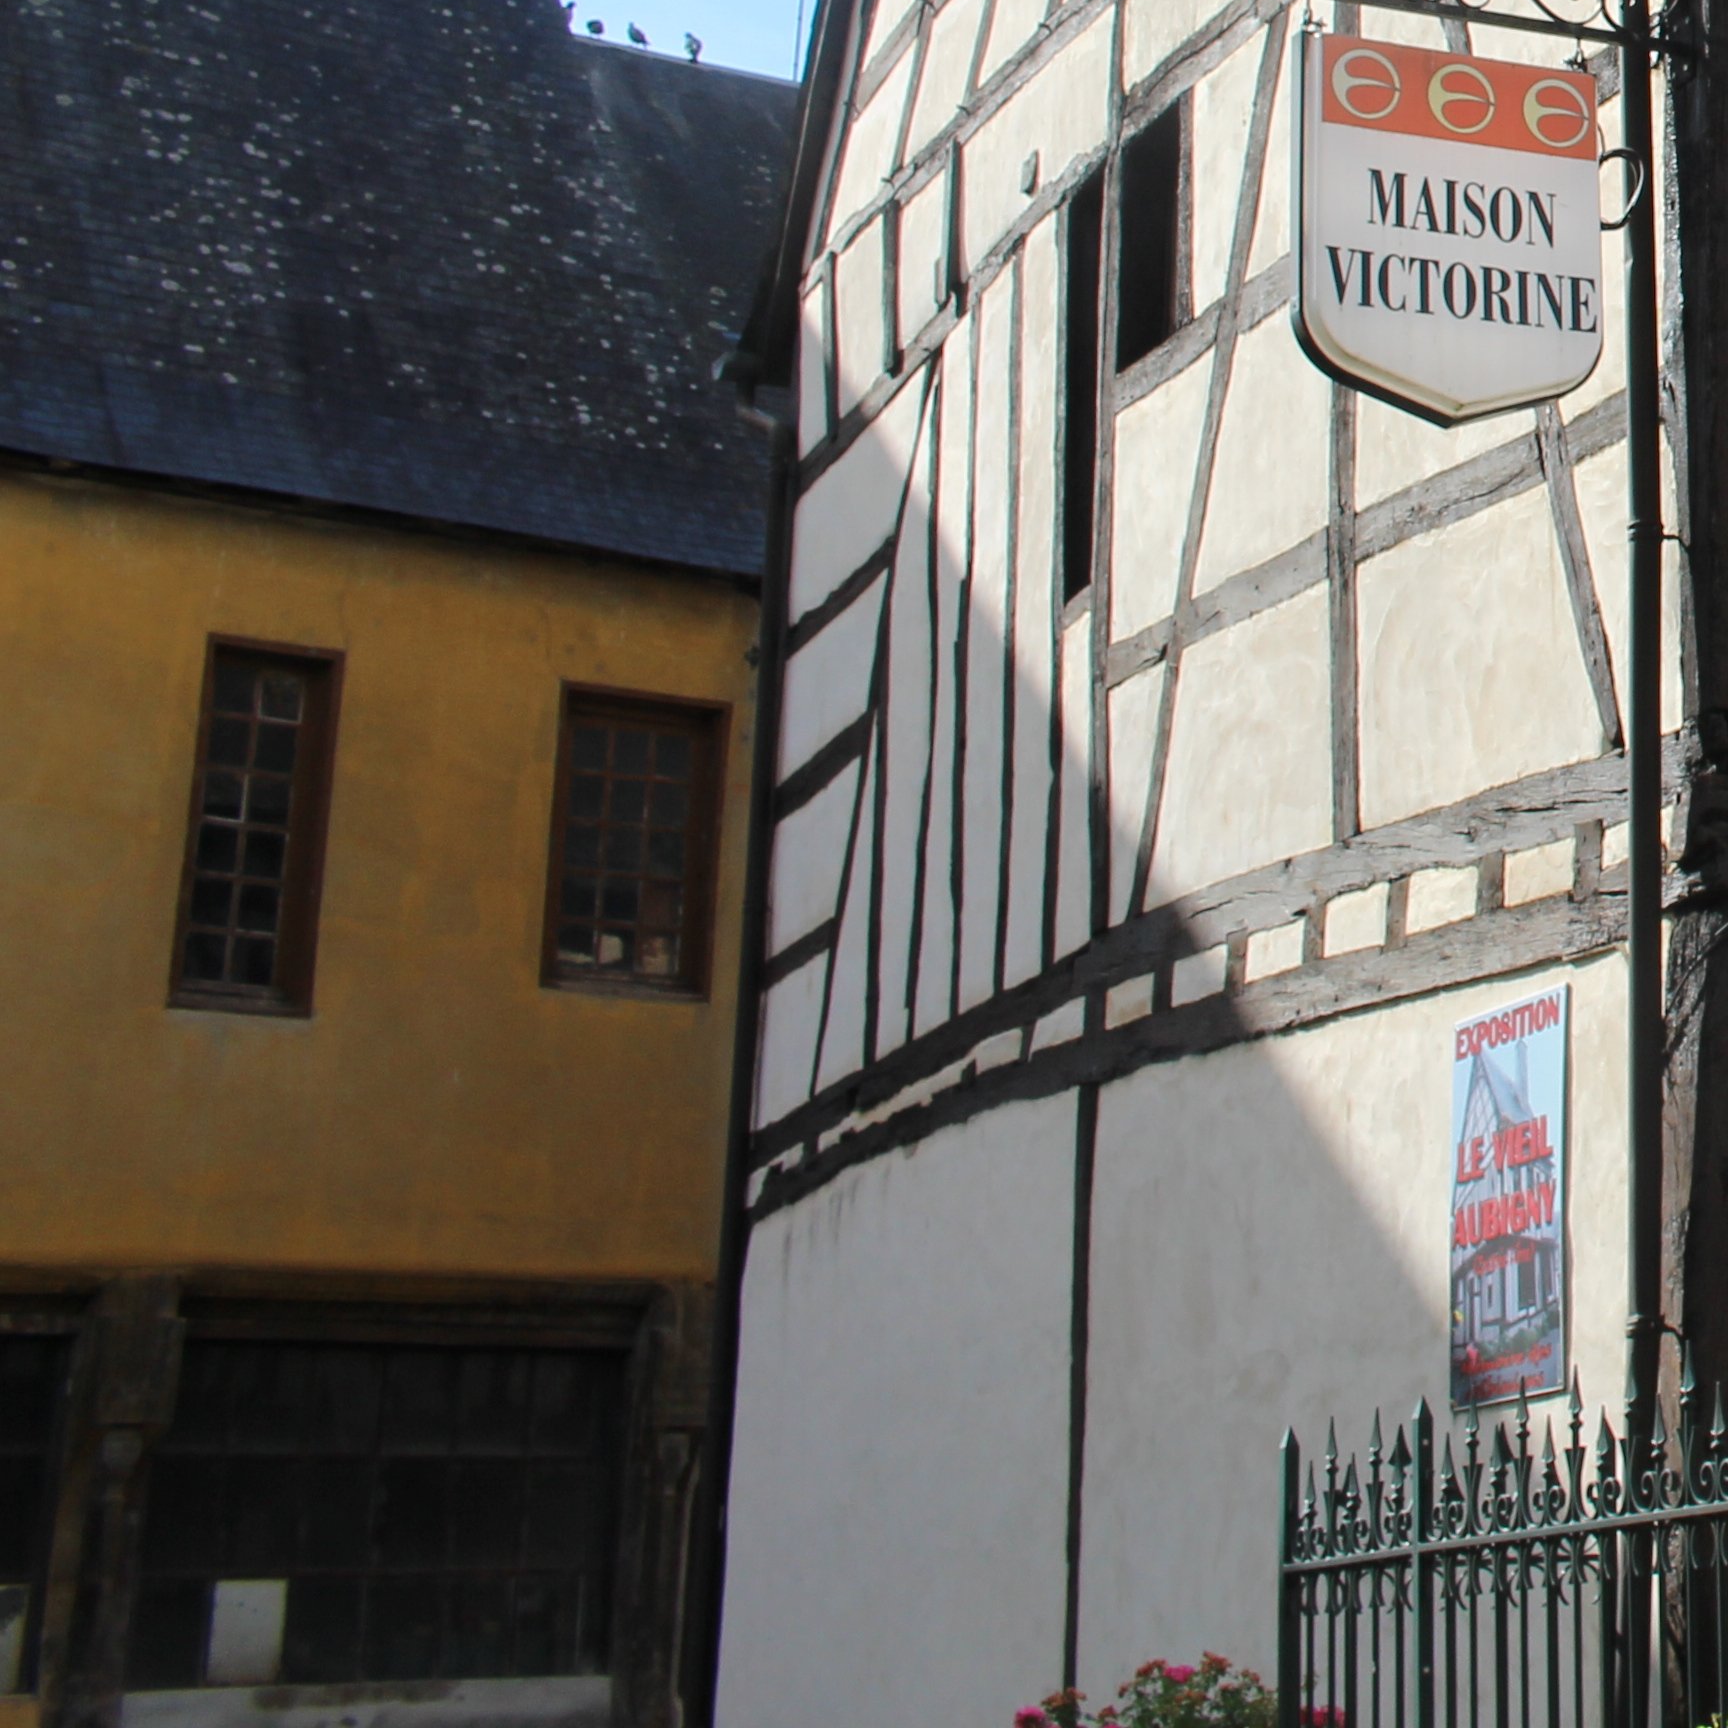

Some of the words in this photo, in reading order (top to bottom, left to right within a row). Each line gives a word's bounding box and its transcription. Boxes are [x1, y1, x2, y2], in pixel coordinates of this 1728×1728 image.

[1366, 167, 1557, 249] MAISON
[1325, 244, 1598, 334] VICTORINE
[1455, 994, 1560, 1061] EXPOSITION
[1457, 1135, 1486, 1184] LE
[1492, 1114, 1554, 1171] VIEIL
[1452, 1177, 1557, 1251] AUBIGNY
